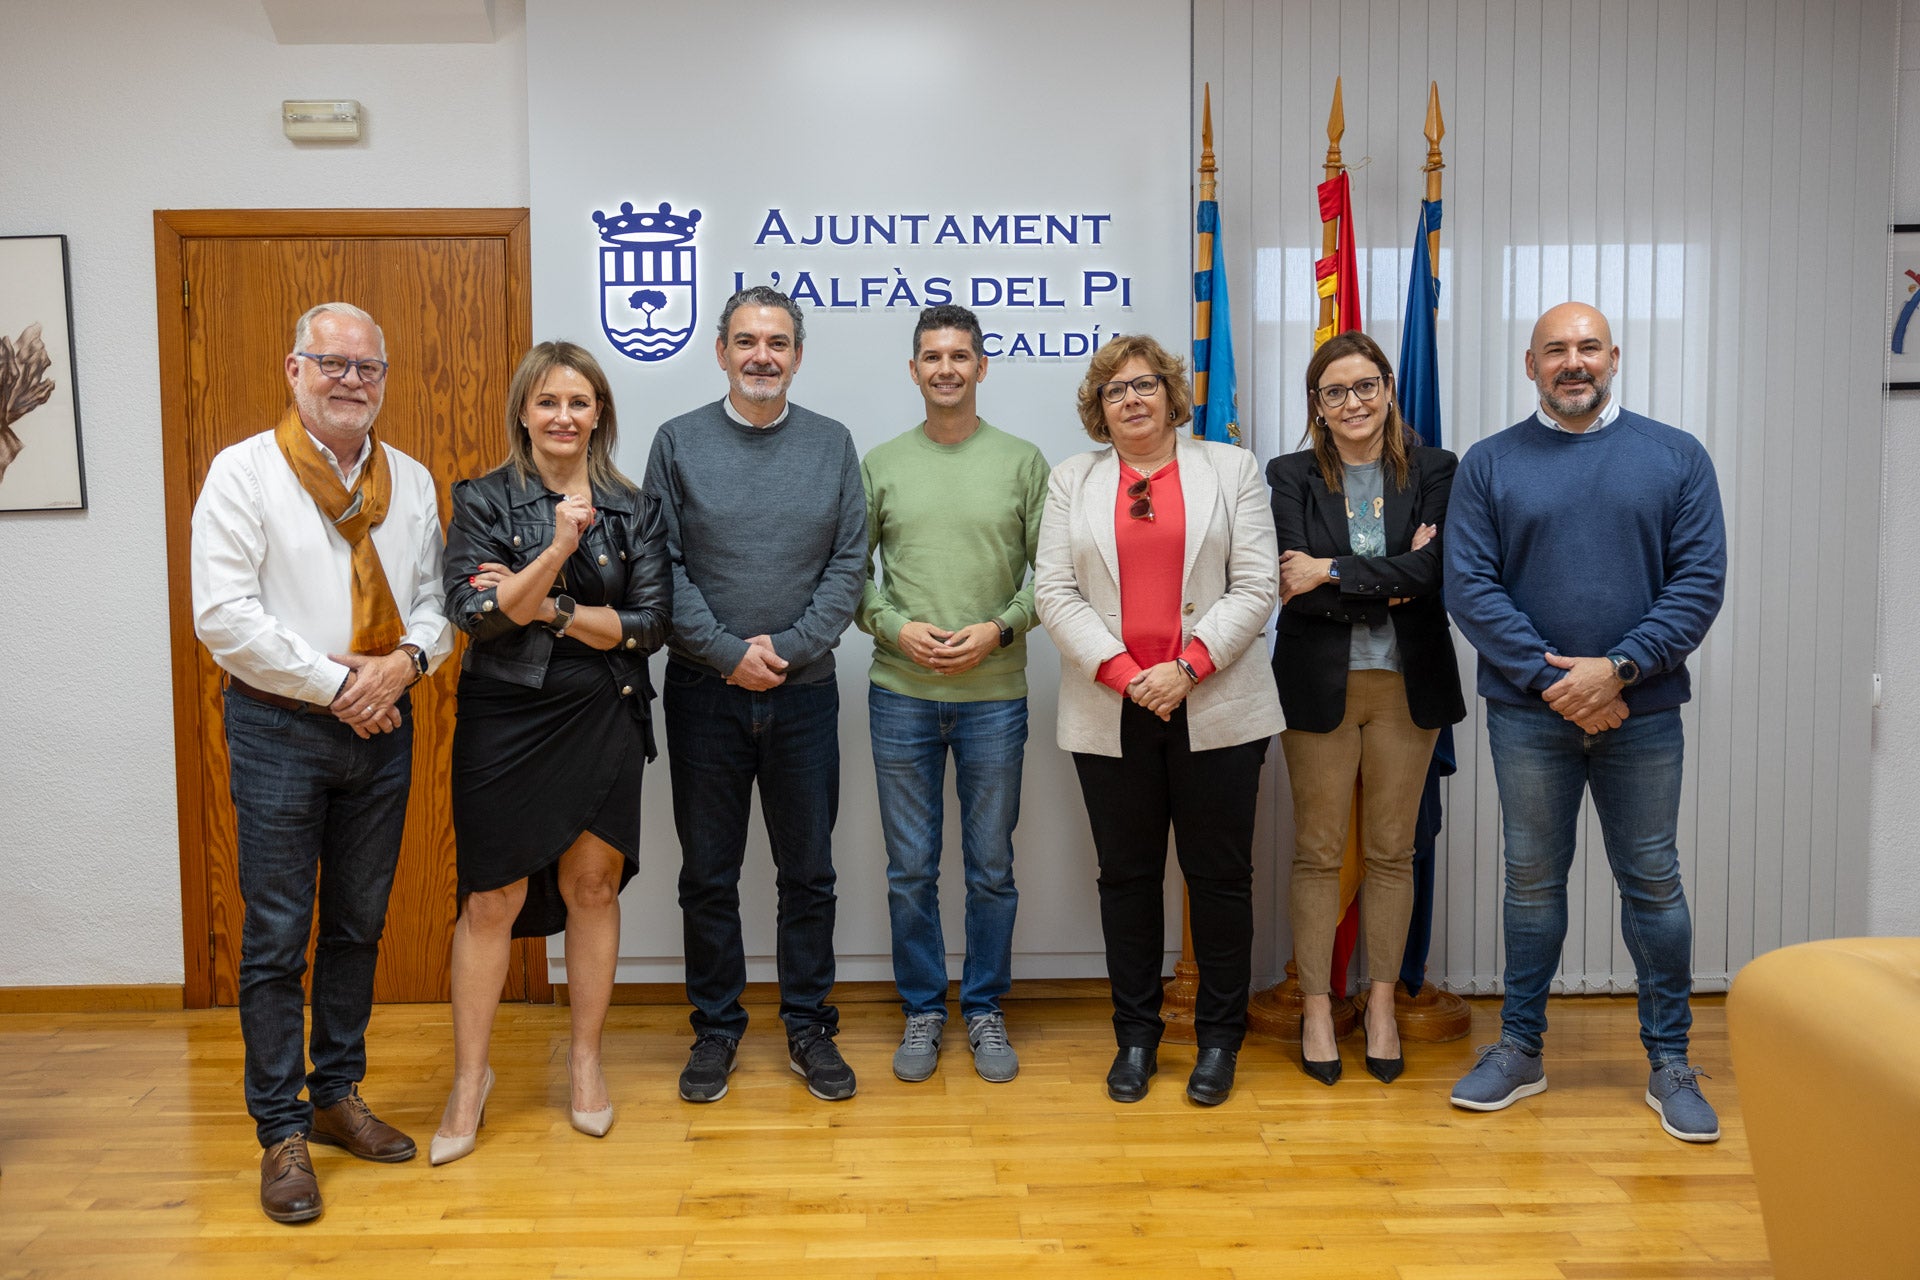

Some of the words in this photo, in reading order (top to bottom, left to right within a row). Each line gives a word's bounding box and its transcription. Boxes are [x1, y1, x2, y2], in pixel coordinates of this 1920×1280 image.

[754, 208, 1111, 245] AJUNTAMENT
[971, 276, 1065, 307] DEL
[1082, 270, 1132, 307] PI
[982, 324, 1121, 357] CALDÍ
